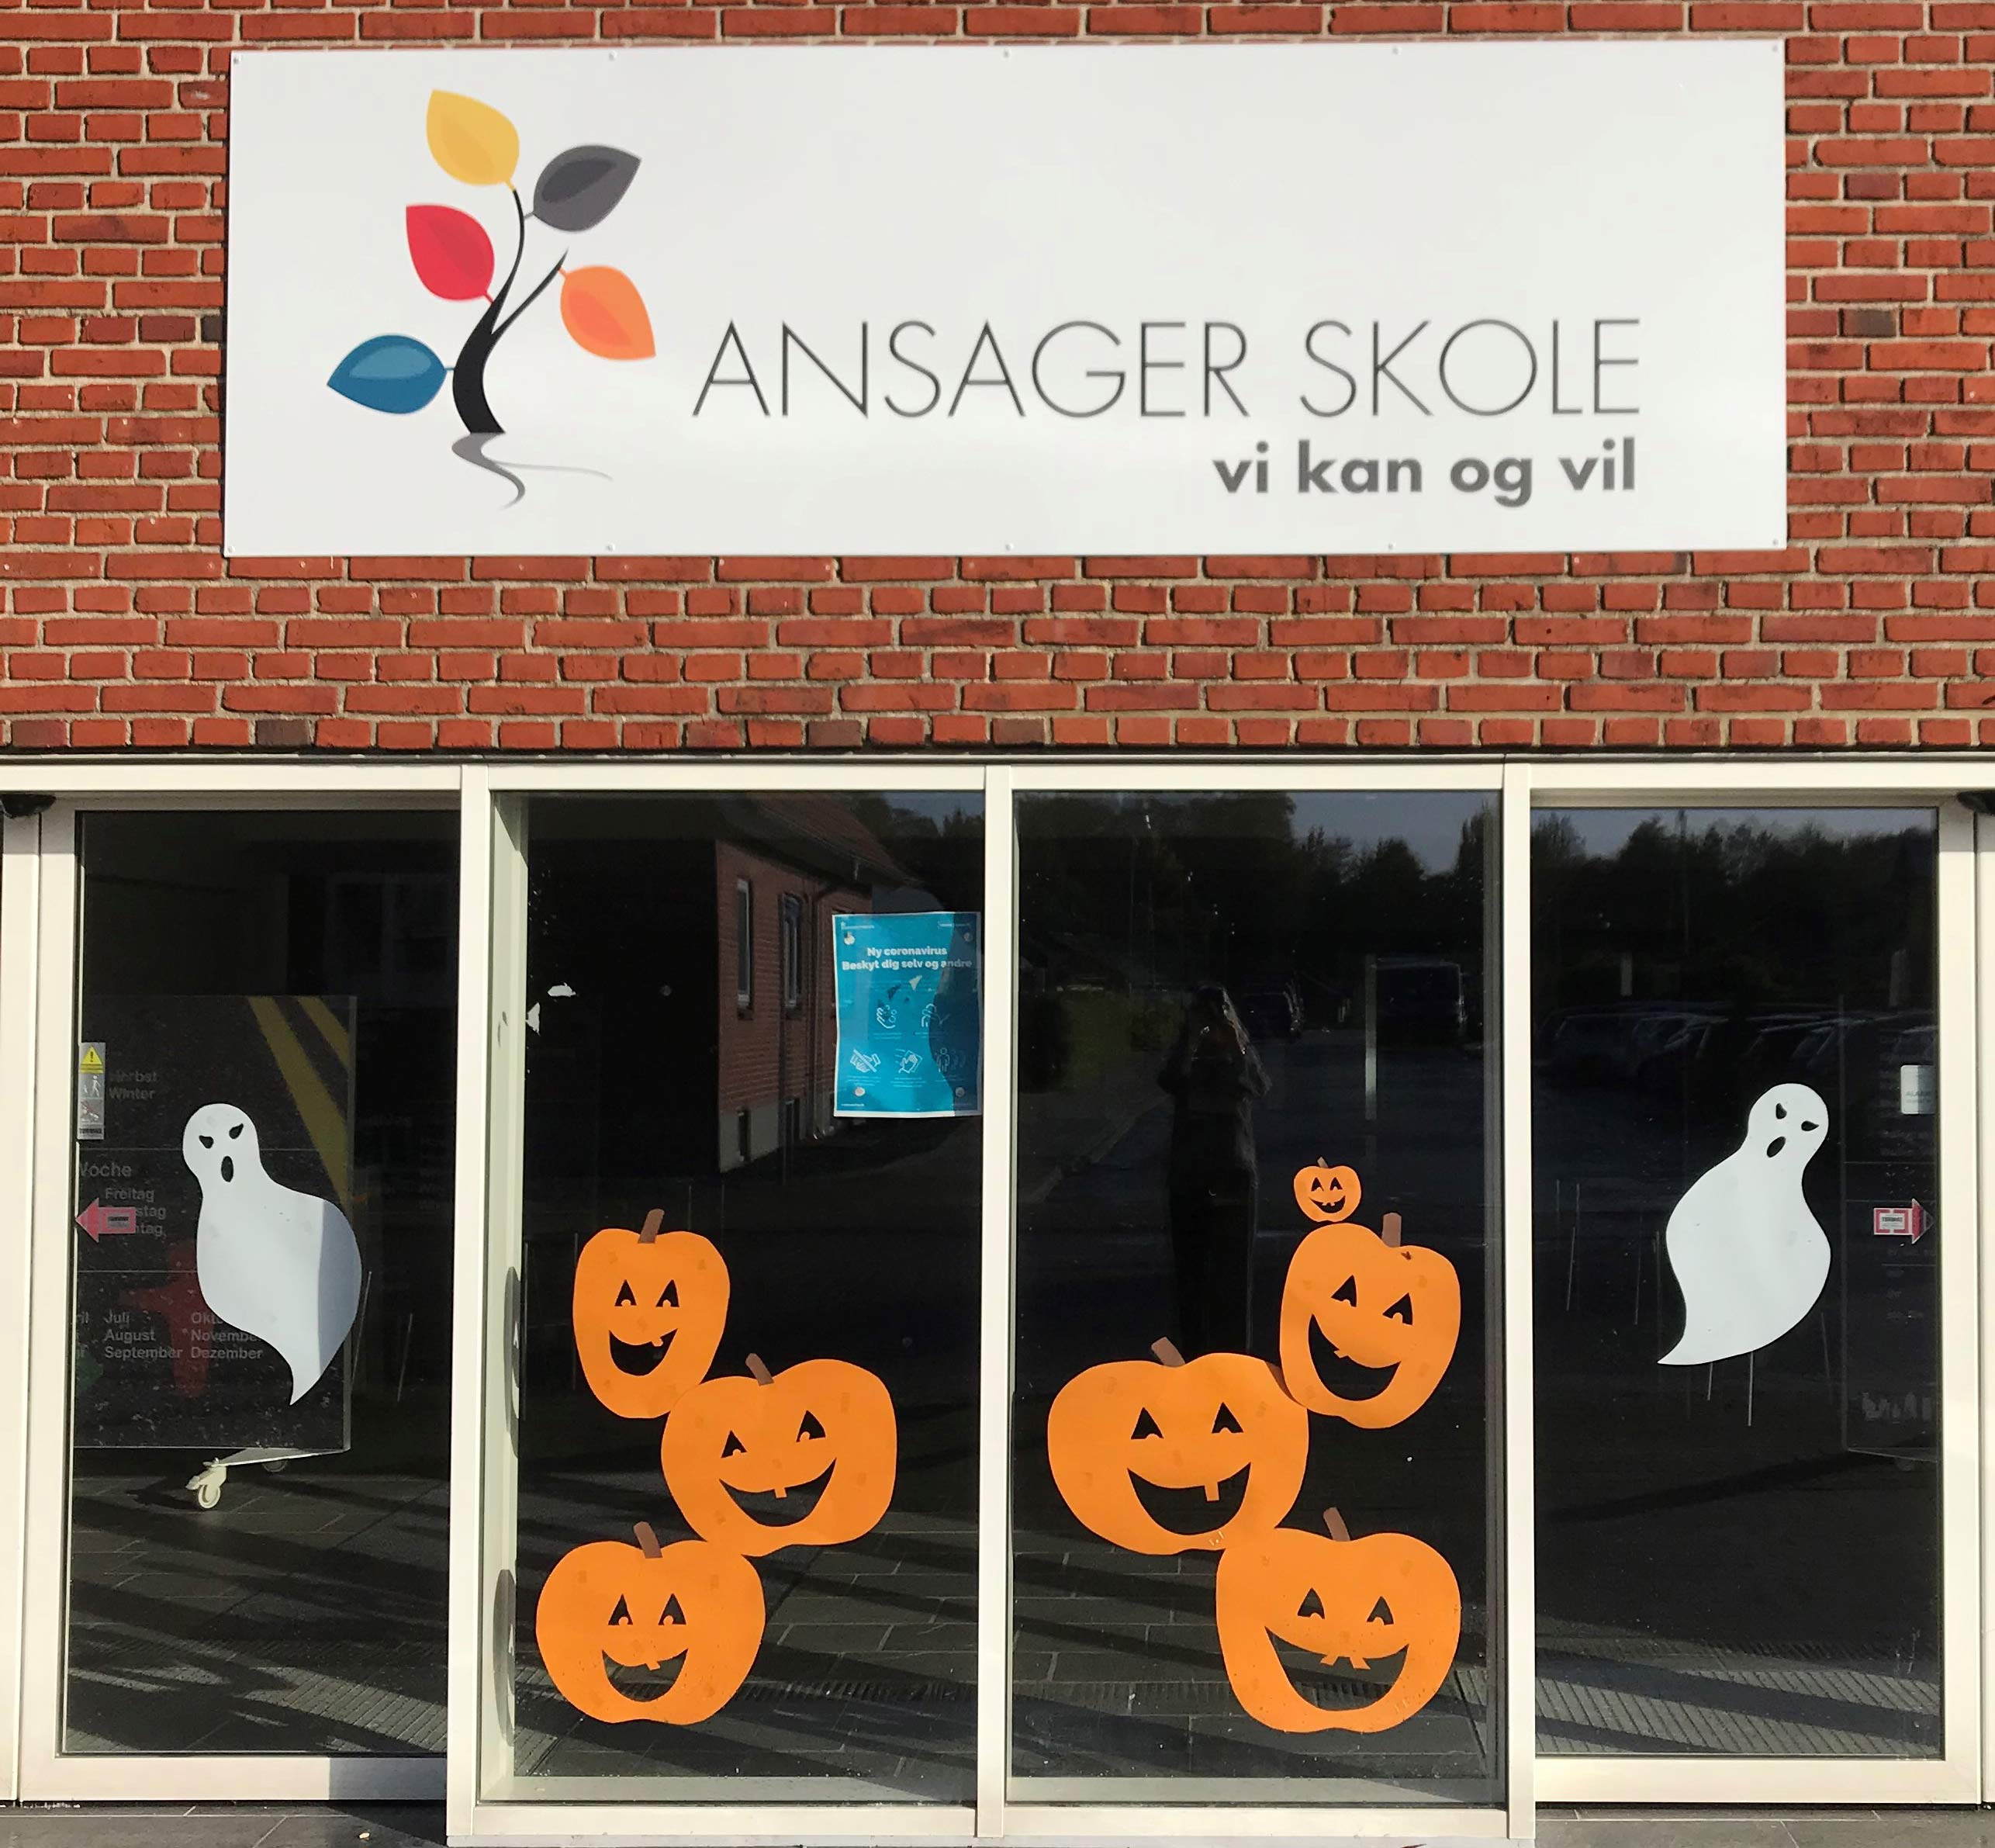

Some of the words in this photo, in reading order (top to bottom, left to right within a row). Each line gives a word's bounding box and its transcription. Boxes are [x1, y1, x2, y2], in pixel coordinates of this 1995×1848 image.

[693, 319, 1250, 419] ANSAGER
[1298, 319, 1641, 418] SKOLE
[1212, 441, 1269, 493] vi
[1297, 438, 1423, 493] kan
[1449, 456, 1533, 509] og
[1558, 436, 1636, 491] vil
[866, 947, 882, 959] Ny
[883, 946, 948, 957] coronavirus
[841, 960, 880, 972] Beskyt
[881, 959, 900, 971] dig
[901, 959, 923, 968] selv
[925, 960, 939, 970] og
[941, 958, 973, 969] andre
[109, 1086, 156, 1099] Winter
[105, 1187, 155, 1203] Freitag
[104, 1309, 130, 1324] Juli
[104, 1328, 156, 1344] August
[191, 1328, 261, 1342] Novembe
[105, 1345, 183, 1361] September
[191, 1346, 264, 1360] Dezember
